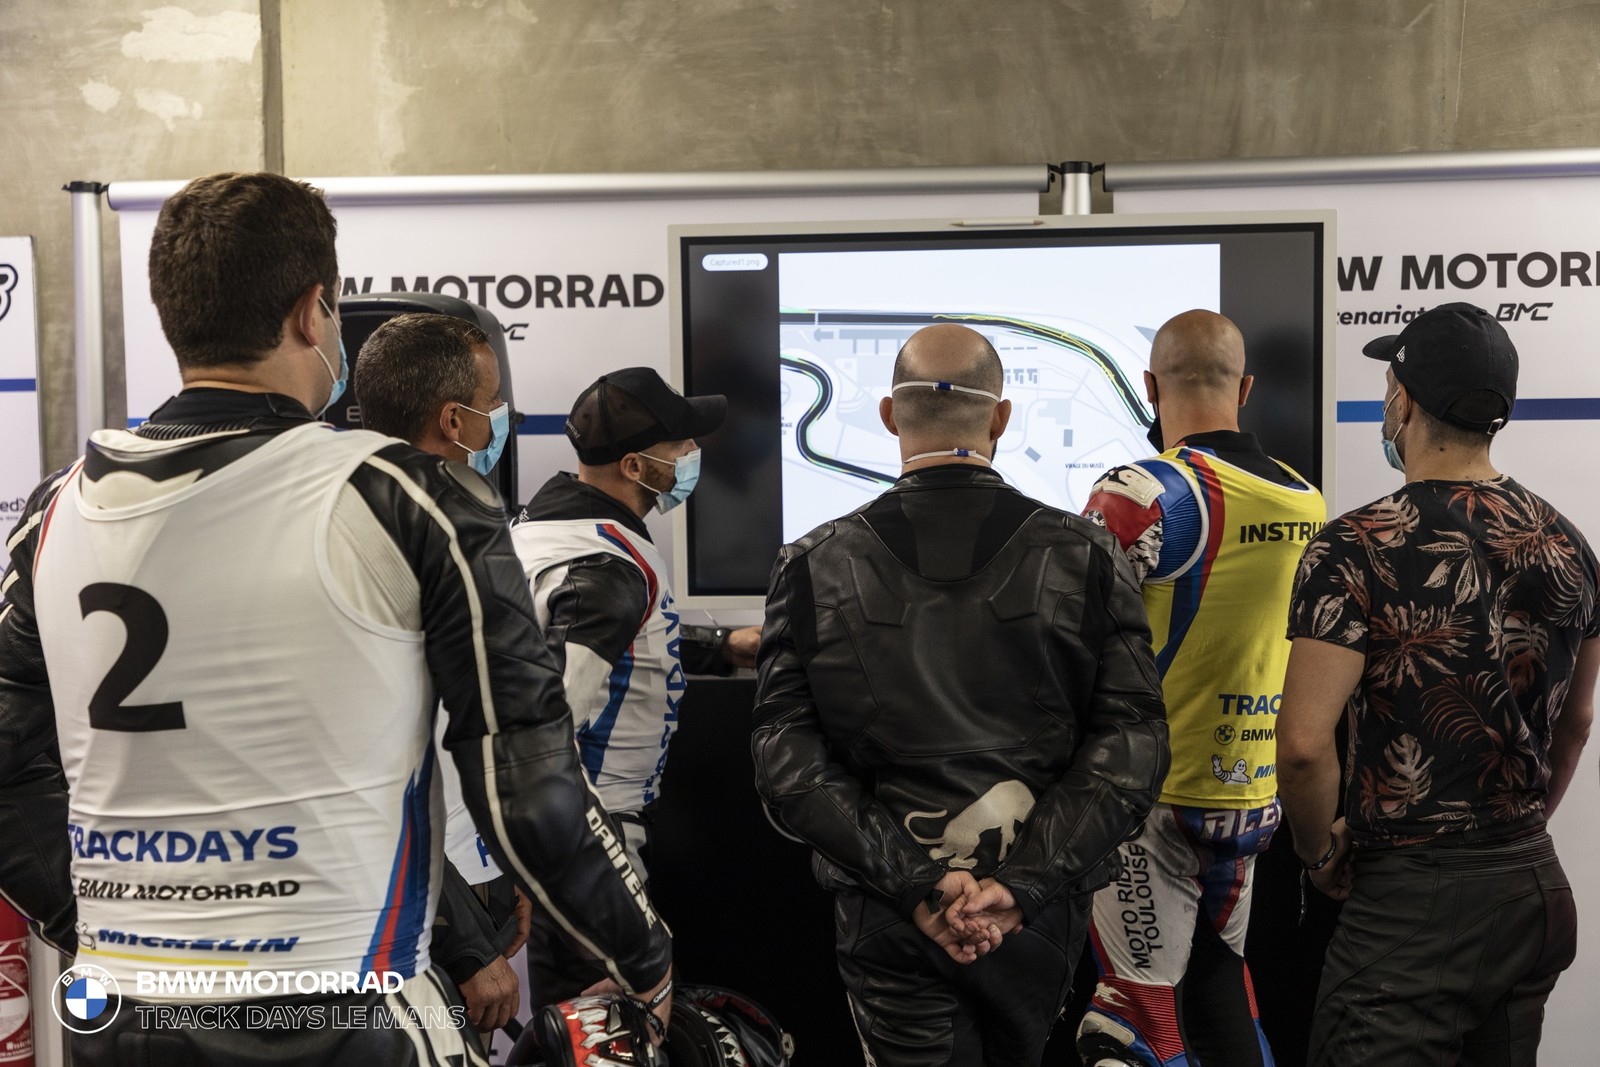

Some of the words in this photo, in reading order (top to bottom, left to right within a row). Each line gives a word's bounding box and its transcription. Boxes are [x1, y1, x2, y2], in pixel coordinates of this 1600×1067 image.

[1401, 251, 1600, 290] MOTOR
[1337, 304, 1428, 325] enaria
[78, 582, 187, 732] 2
[1240, 728, 1277, 742] BMW
[585, 805, 657, 930] DAINESE
[78, 878, 131, 899] BMW
[133, 879, 301, 901] MOTORRAD
[1127, 844, 1163, 953] TOULOUSE
[98, 928, 300, 952] MICHELIN
[1121, 909, 1152, 969] MOTO
